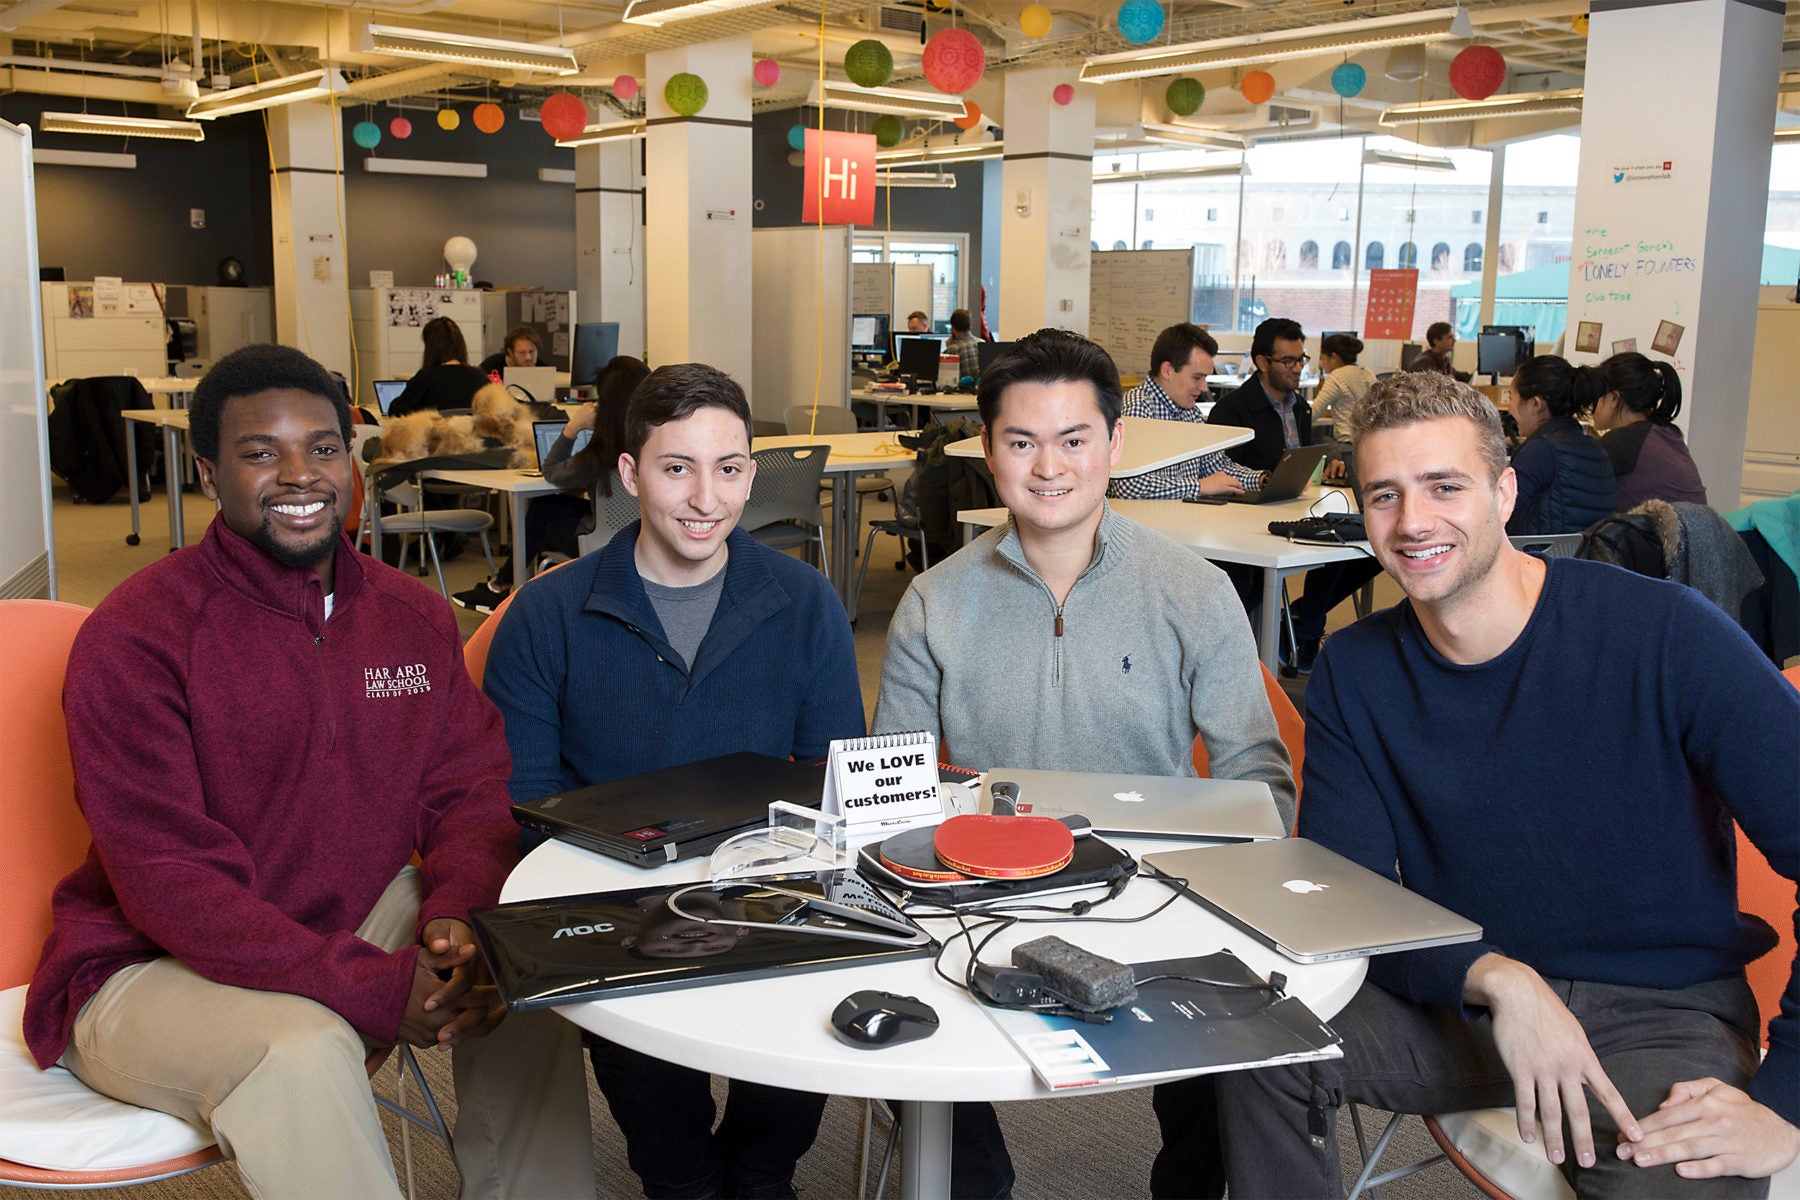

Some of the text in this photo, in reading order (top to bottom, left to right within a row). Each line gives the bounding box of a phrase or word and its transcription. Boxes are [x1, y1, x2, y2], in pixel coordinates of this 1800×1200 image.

[823, 156, 858, 200] Hi
[1585, 262, 1629, 282] LONELY
[1637, 257, 1697, 275] FOUNDERS
[365, 675, 430, 690] LAW SCHOOL
[848, 753, 925, 773] We LOVE
[875, 775, 902, 787] our
[844, 786, 937, 808] customers!
[552, 923, 615, 939] AOC
